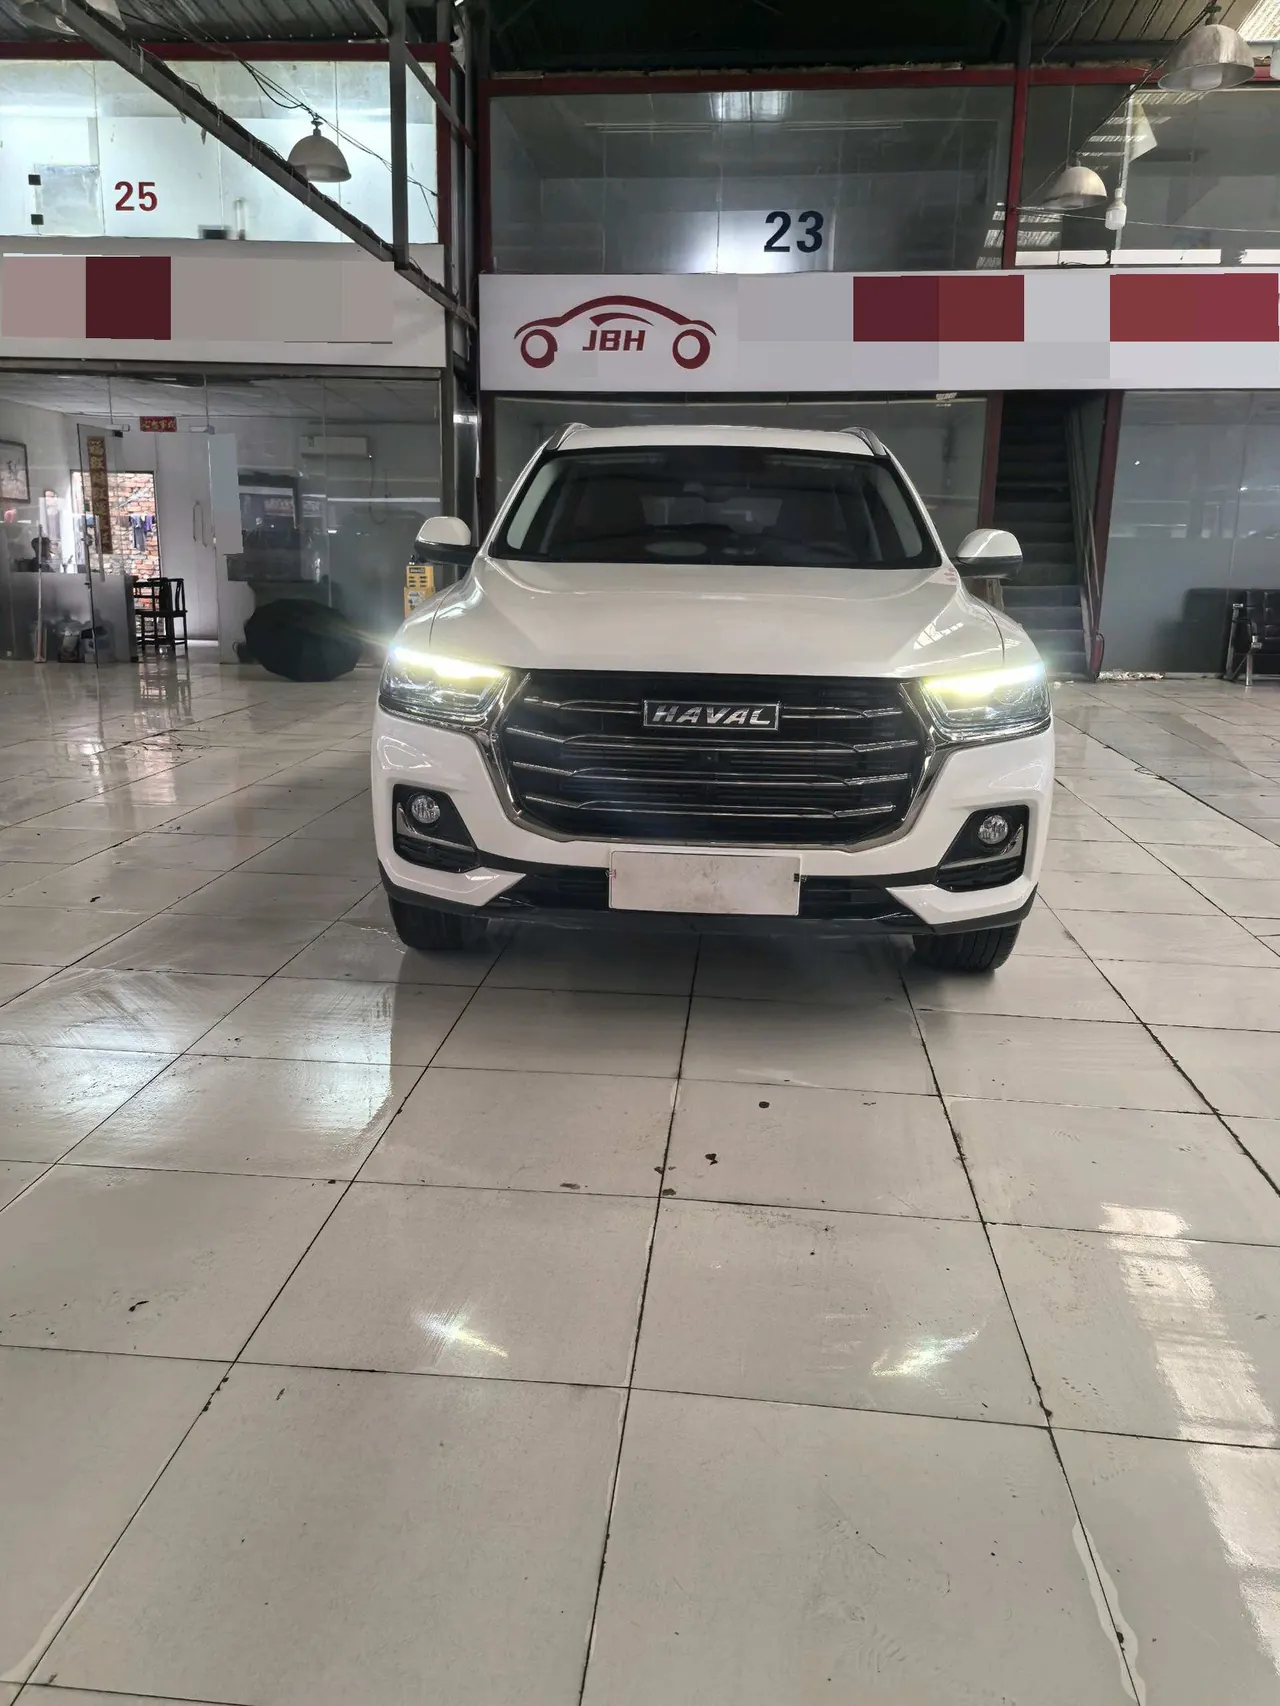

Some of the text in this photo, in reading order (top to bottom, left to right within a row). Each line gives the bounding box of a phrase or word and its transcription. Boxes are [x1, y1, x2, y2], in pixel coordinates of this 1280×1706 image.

[115, 181, 158, 211] 25
[764, 210, 824, 253] 23
[582, 329, 646, 352] JBH
[652, 704, 770, 725] HAVAL
